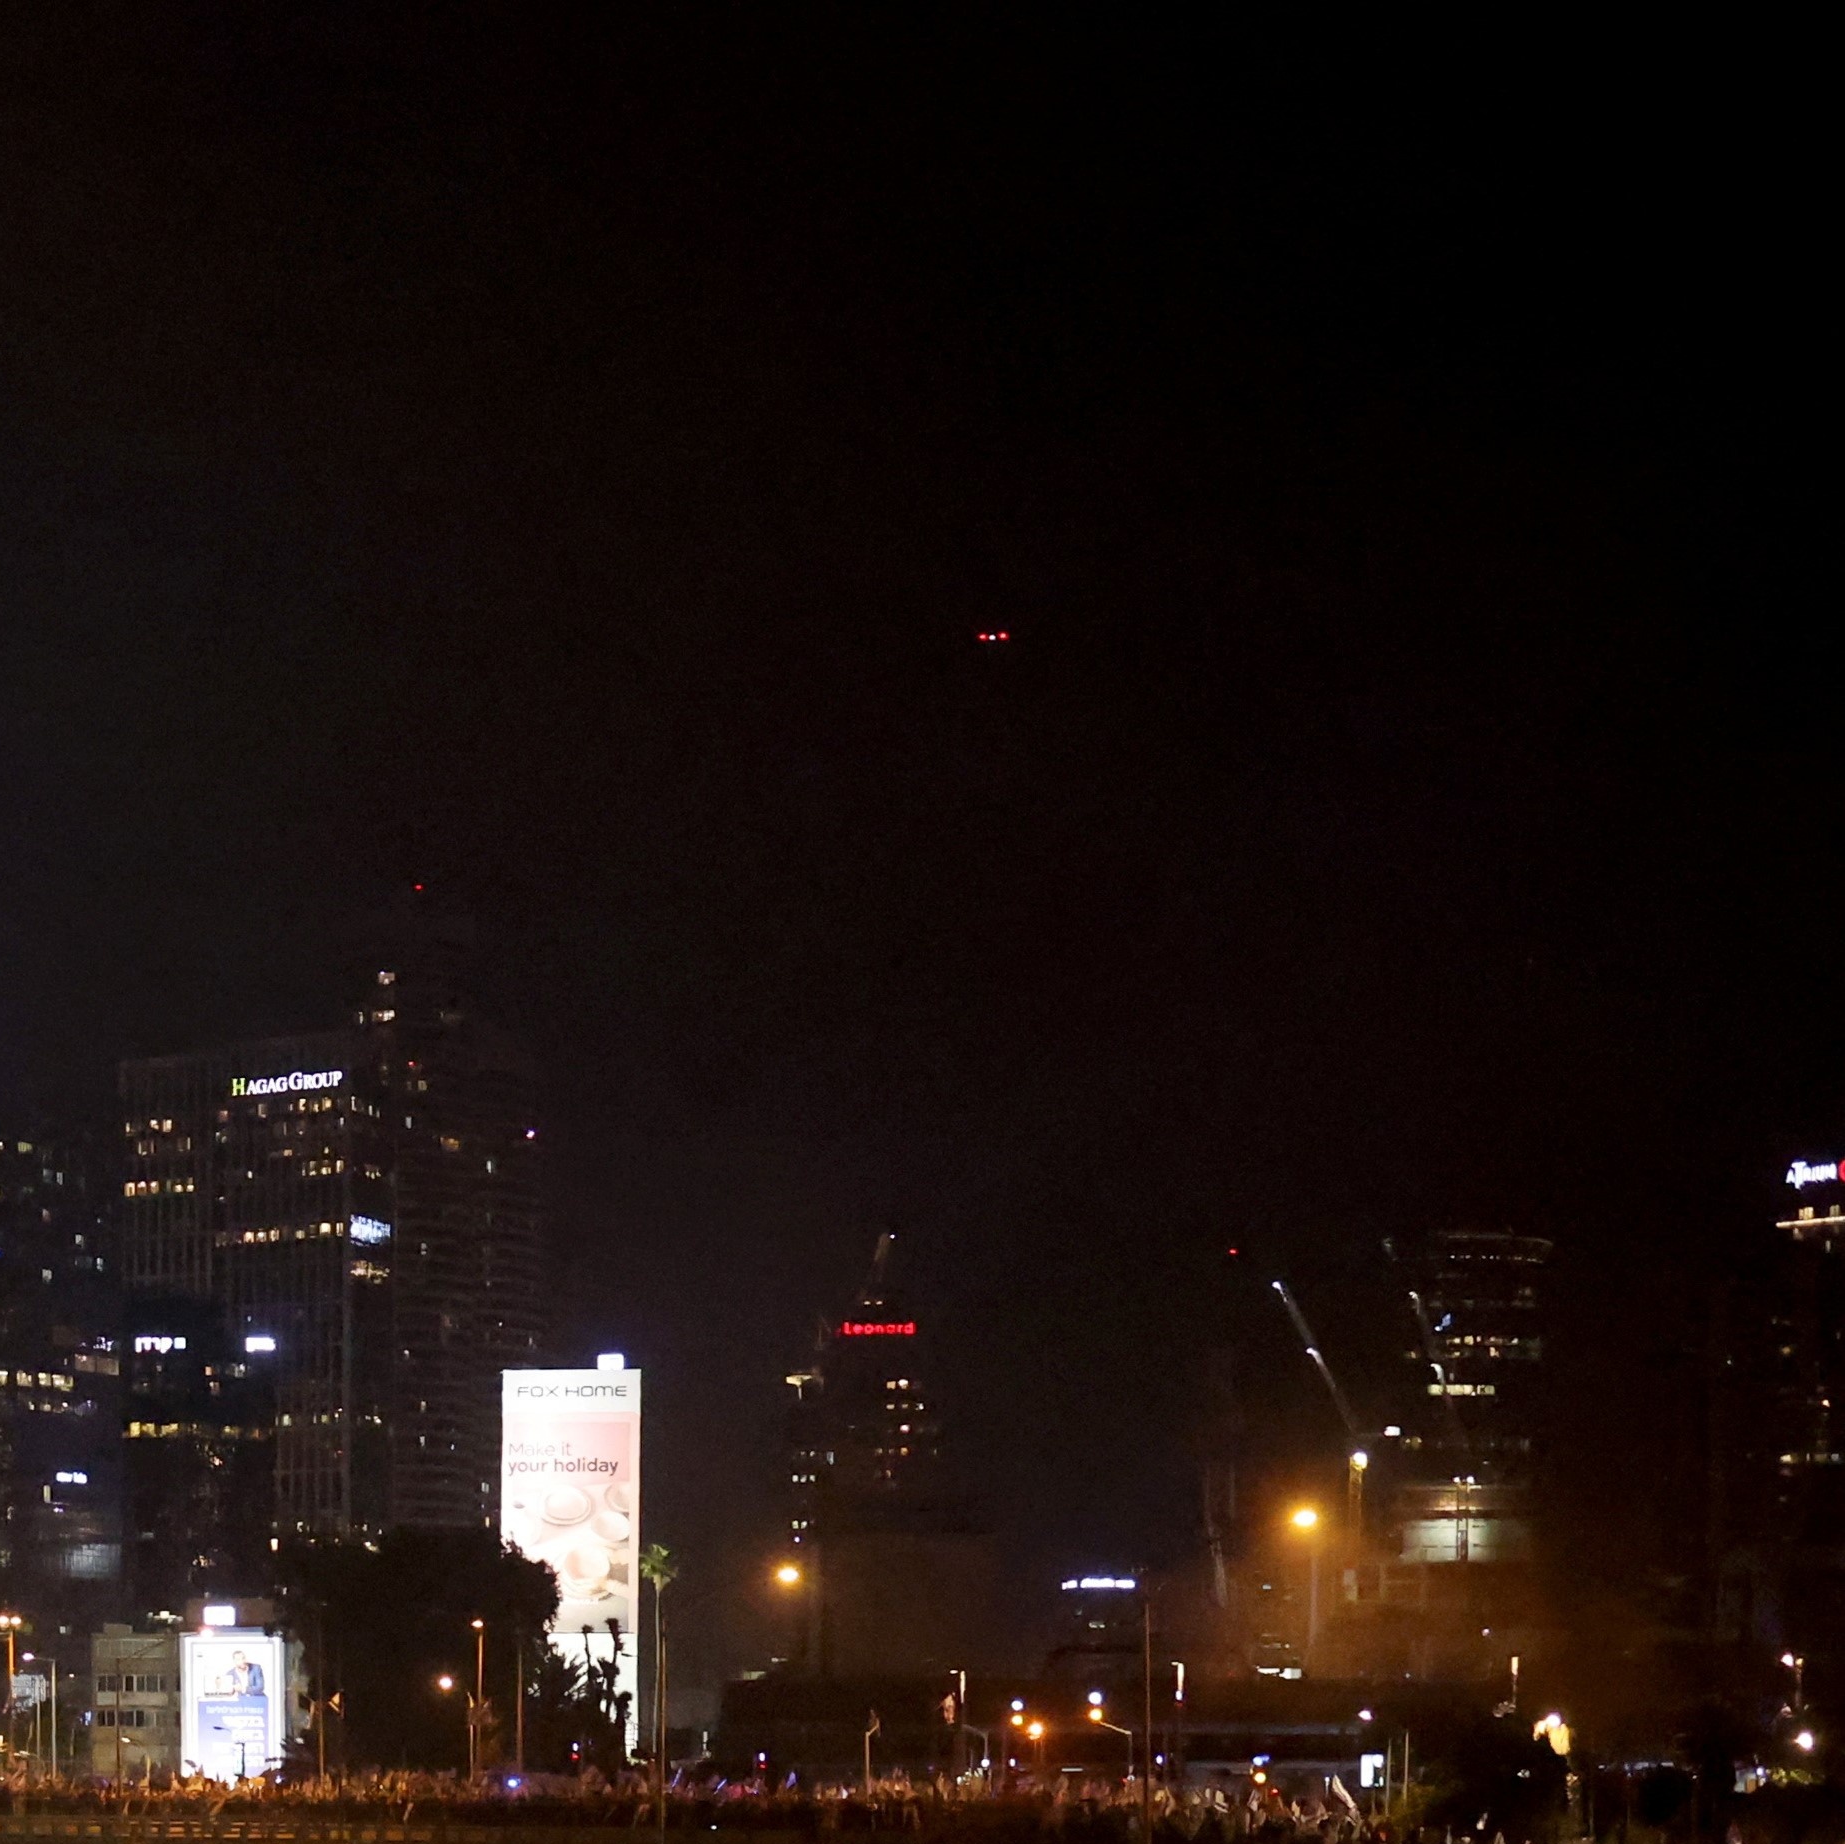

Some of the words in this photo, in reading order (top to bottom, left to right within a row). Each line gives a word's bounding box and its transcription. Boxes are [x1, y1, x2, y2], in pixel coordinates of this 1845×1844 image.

[843, 1321, 915, 1335] Leonard
[517, 1385, 559, 1397] FOX
[565, 1385, 627, 1397] HOME
[508, 1442, 555, 1457] Make
[559, 1441, 572, 1457] it
[508, 1461, 547, 1477] your
[554, 1457, 620, 1477] holiday
